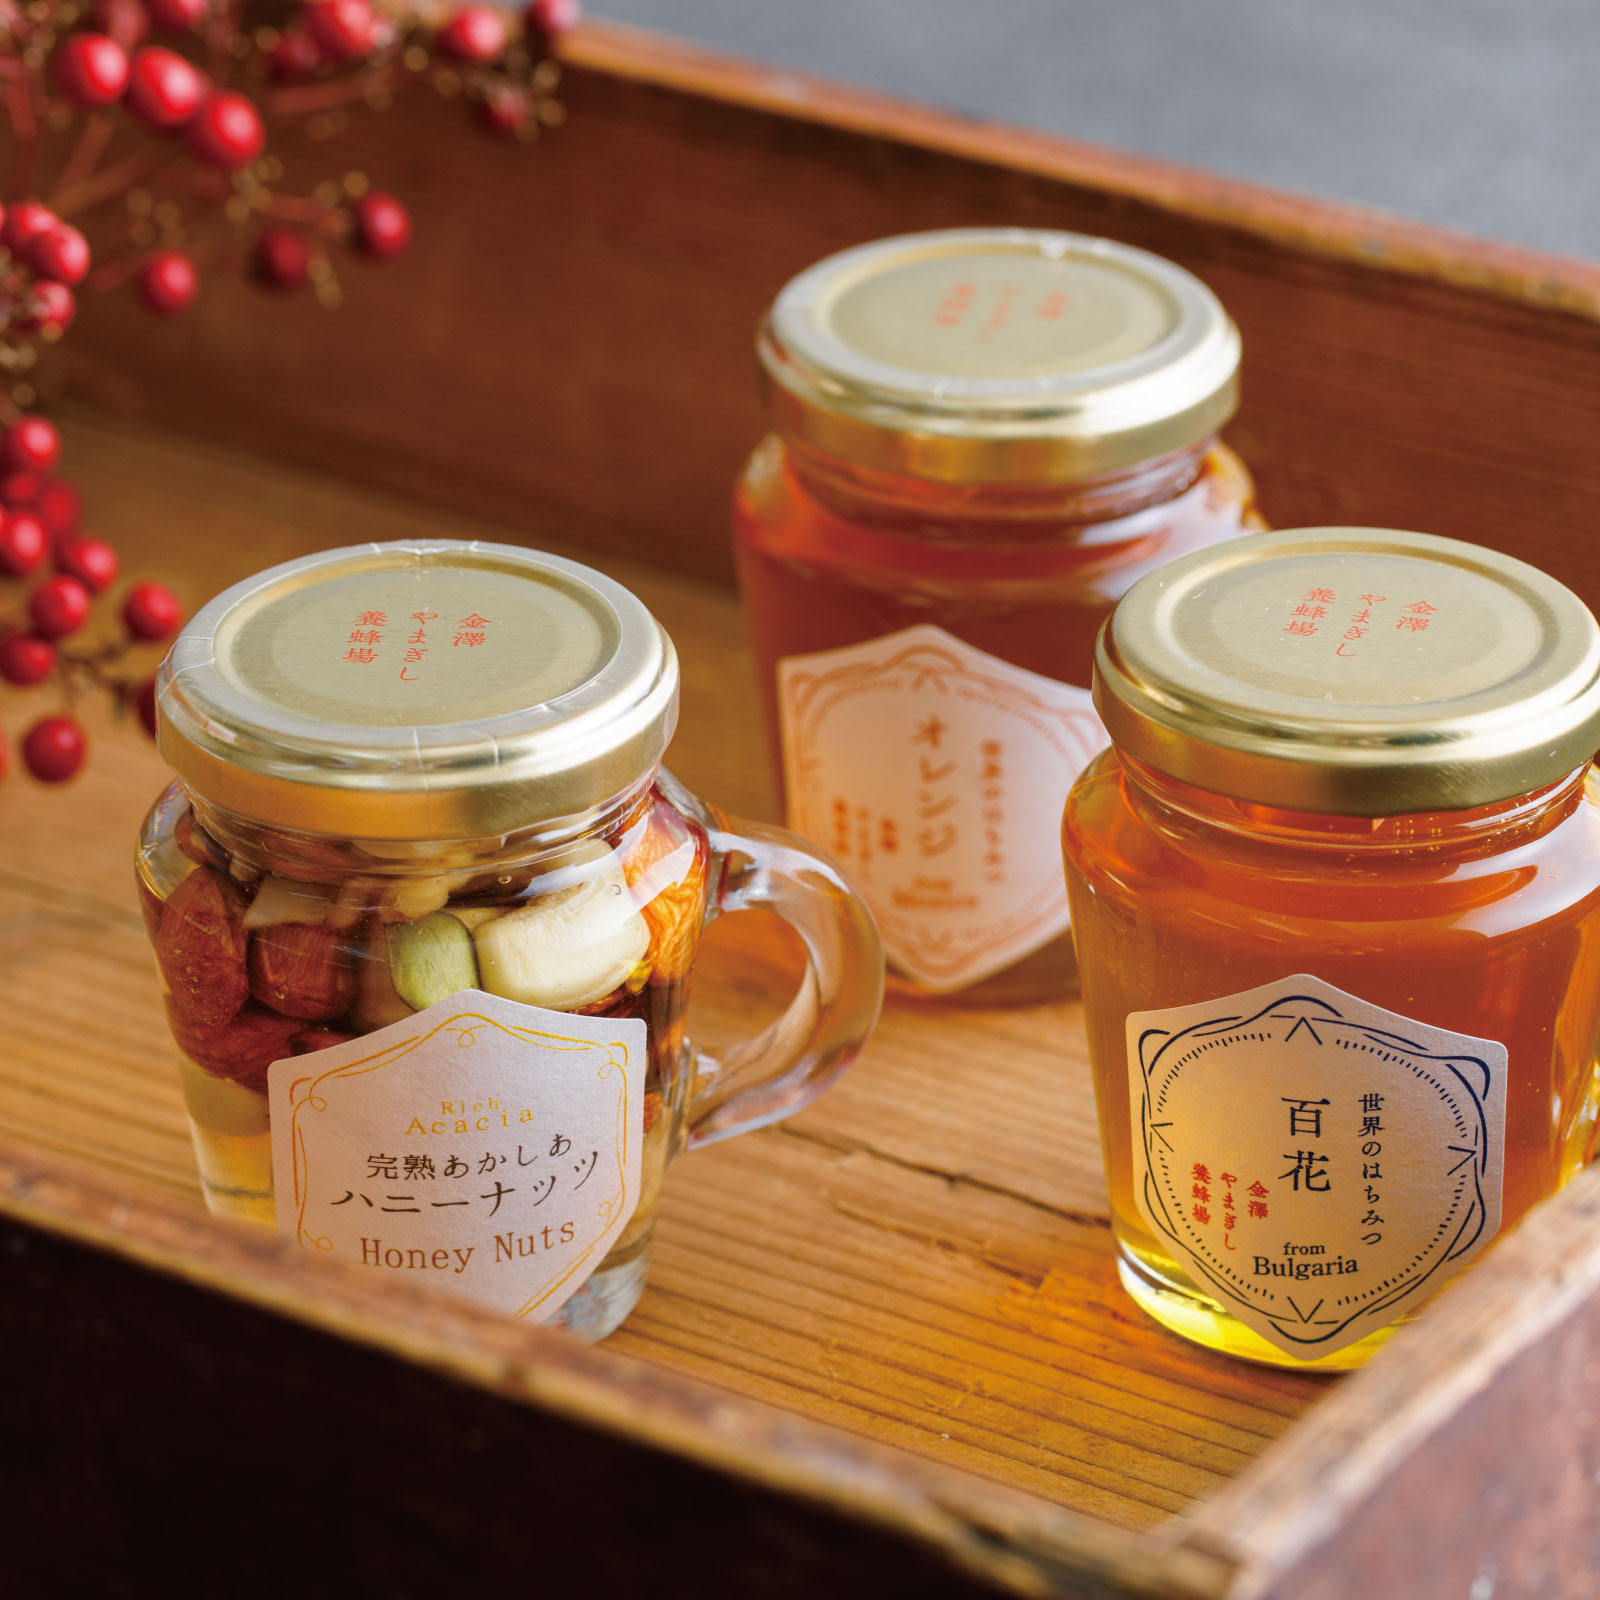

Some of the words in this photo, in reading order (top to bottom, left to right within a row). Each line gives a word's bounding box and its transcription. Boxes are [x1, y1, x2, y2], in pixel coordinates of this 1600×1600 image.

[452, 613, 493, 647] 金澤
[1336, 594, 1387, 657] やまぎし
[1394, 600, 1440, 632] 金澤
[399, 612, 439, 681] やまぎし
[405, 1108, 534, 1135] Acacia
[441, 1097, 499, 1115] Rich
[366, 1133, 571, 1180] 完熟あかしあ
[1278, 1097, 1331, 1192] 百花
[331, 1151, 598, 1217] ハニーナッツ
[1358, 1093, 1385, 1245] 世界のはちみつ
[1220, 1172, 1237, 1251] やまぎし
[1246, 1180, 1269, 1219] 金澤
[360, 1237, 475, 1273] Honey
[495, 1221, 575, 1263] Nuts
[1252, 1255, 1359, 1281] Bulgaria
[1283, 1242, 1326, 1256] from
